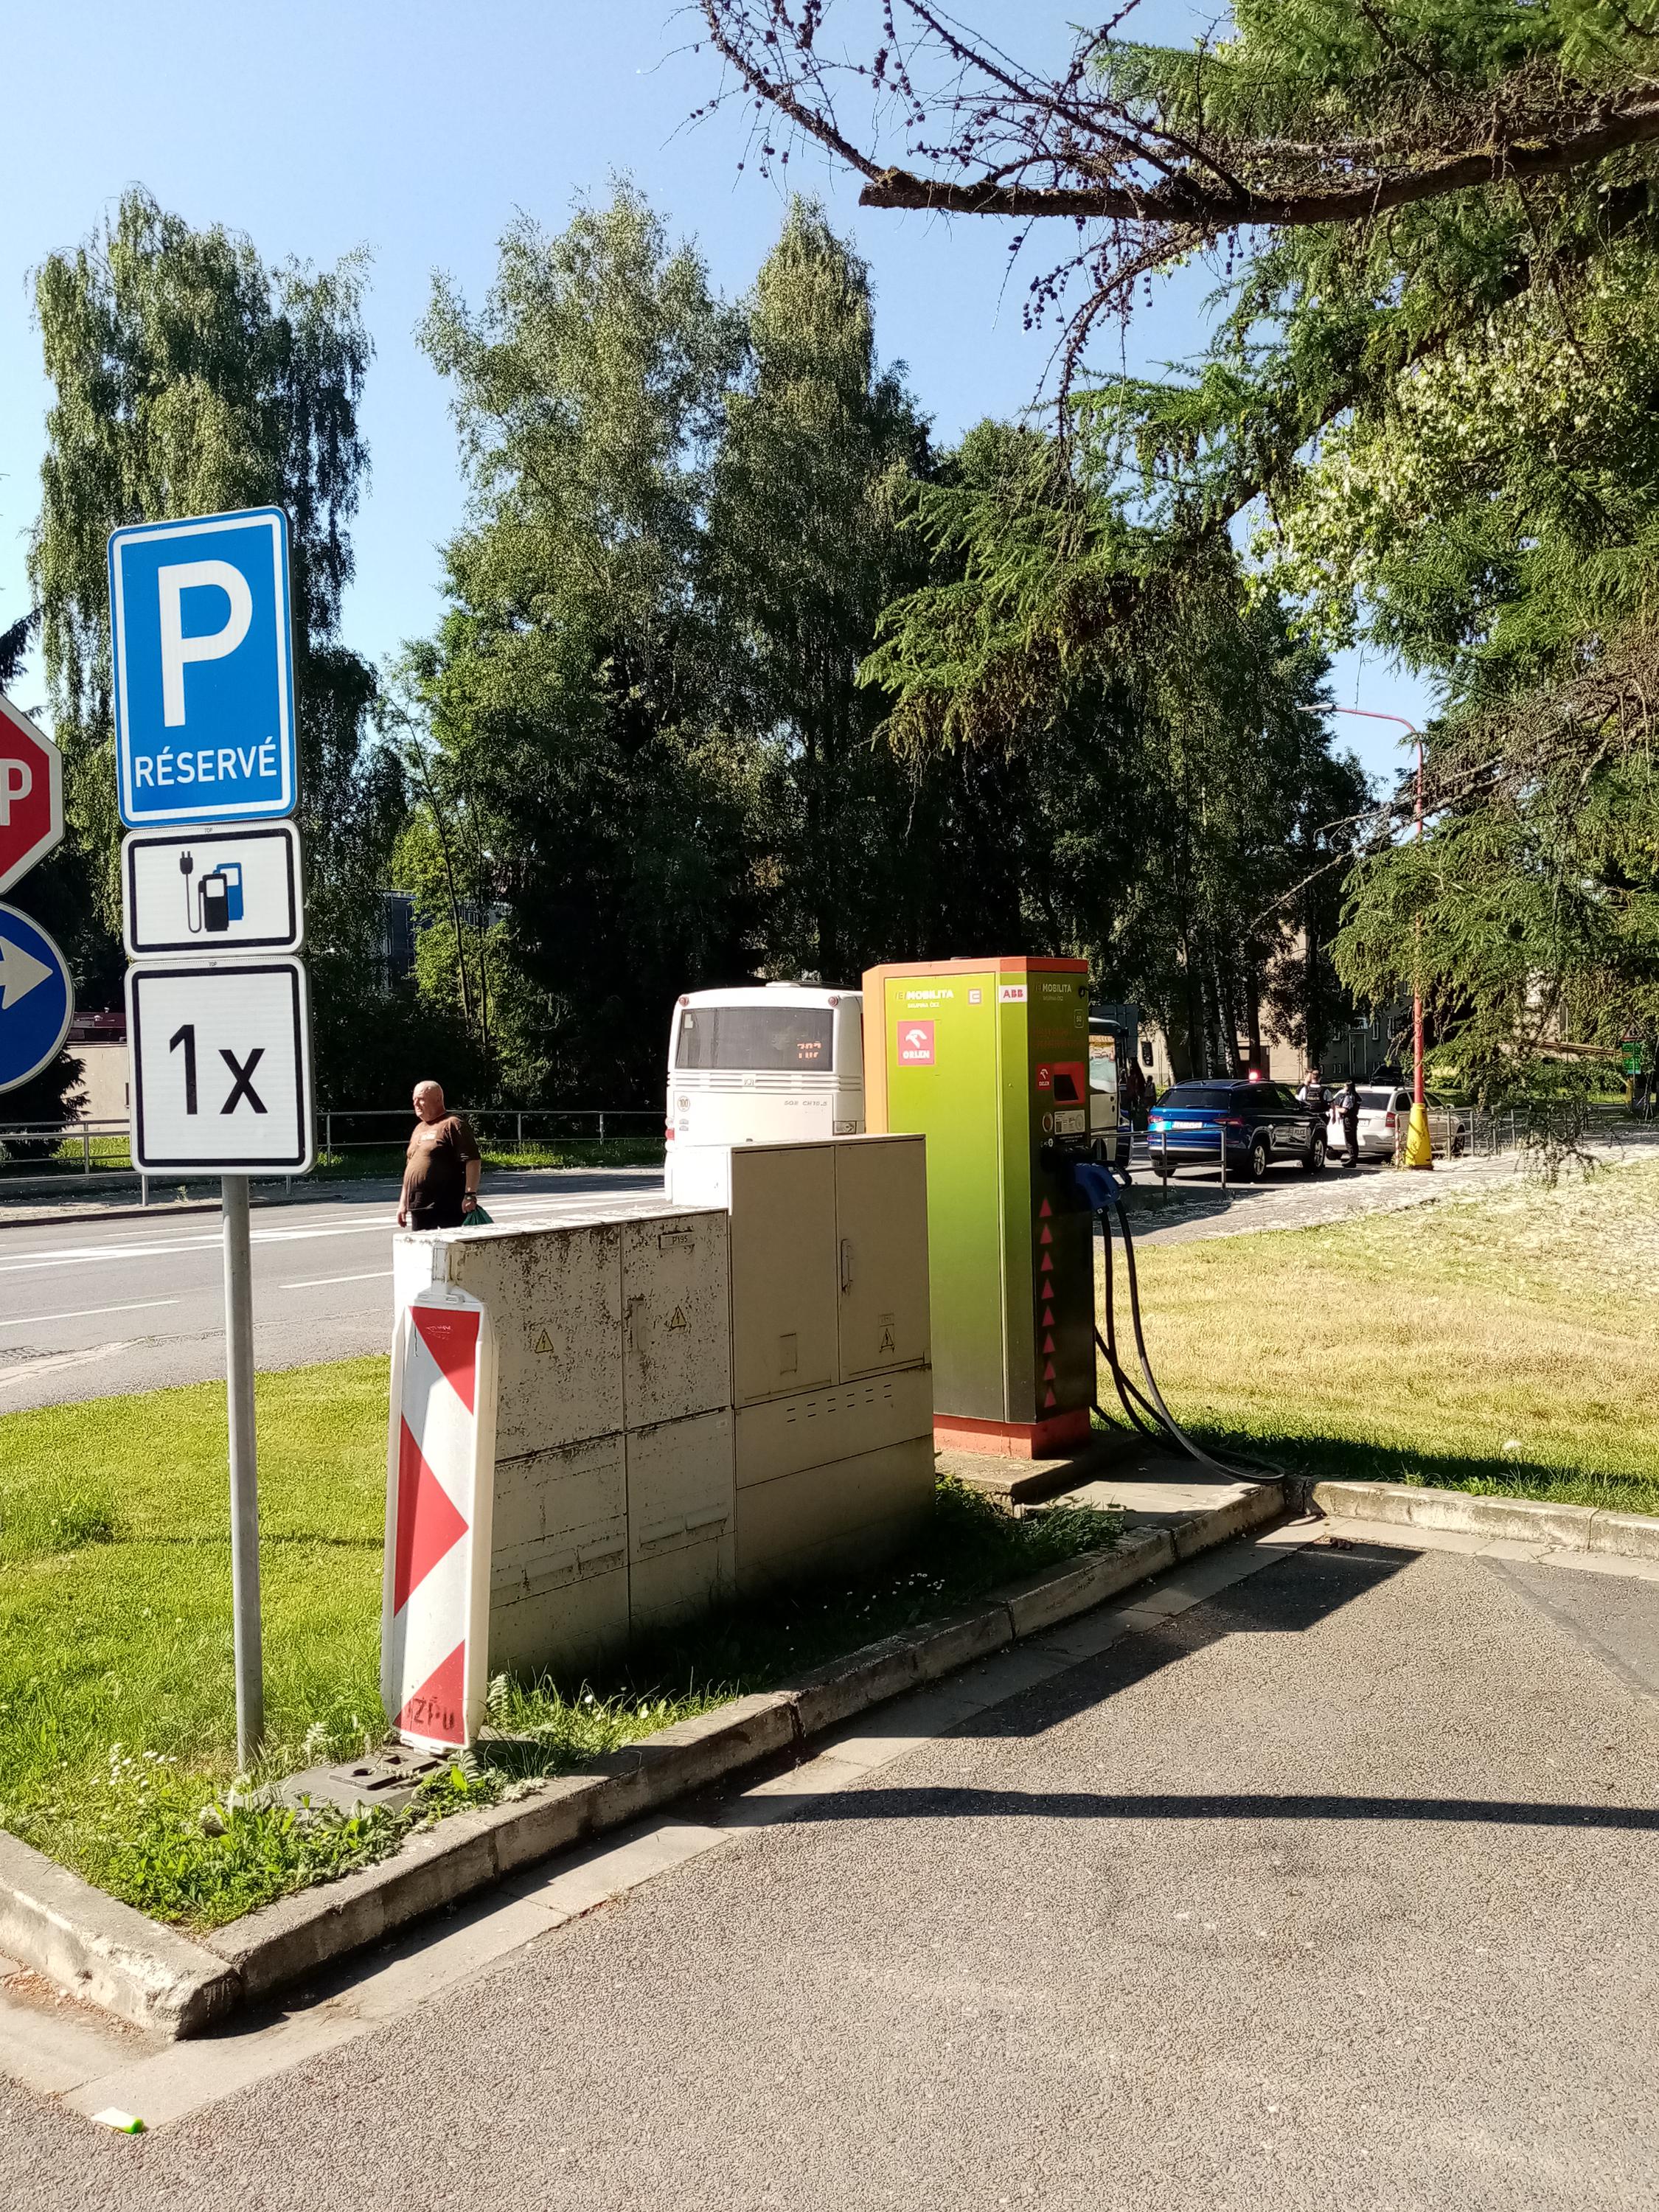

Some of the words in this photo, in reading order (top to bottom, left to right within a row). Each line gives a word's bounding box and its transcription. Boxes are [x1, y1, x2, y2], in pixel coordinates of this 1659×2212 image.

[158, 559, 253, 727] P
[135, 736, 277, 787] RÉSERVÉ
[1003, 989, 1023, 998] ABB
[902, 1050, 931, 1060] ORLEN
